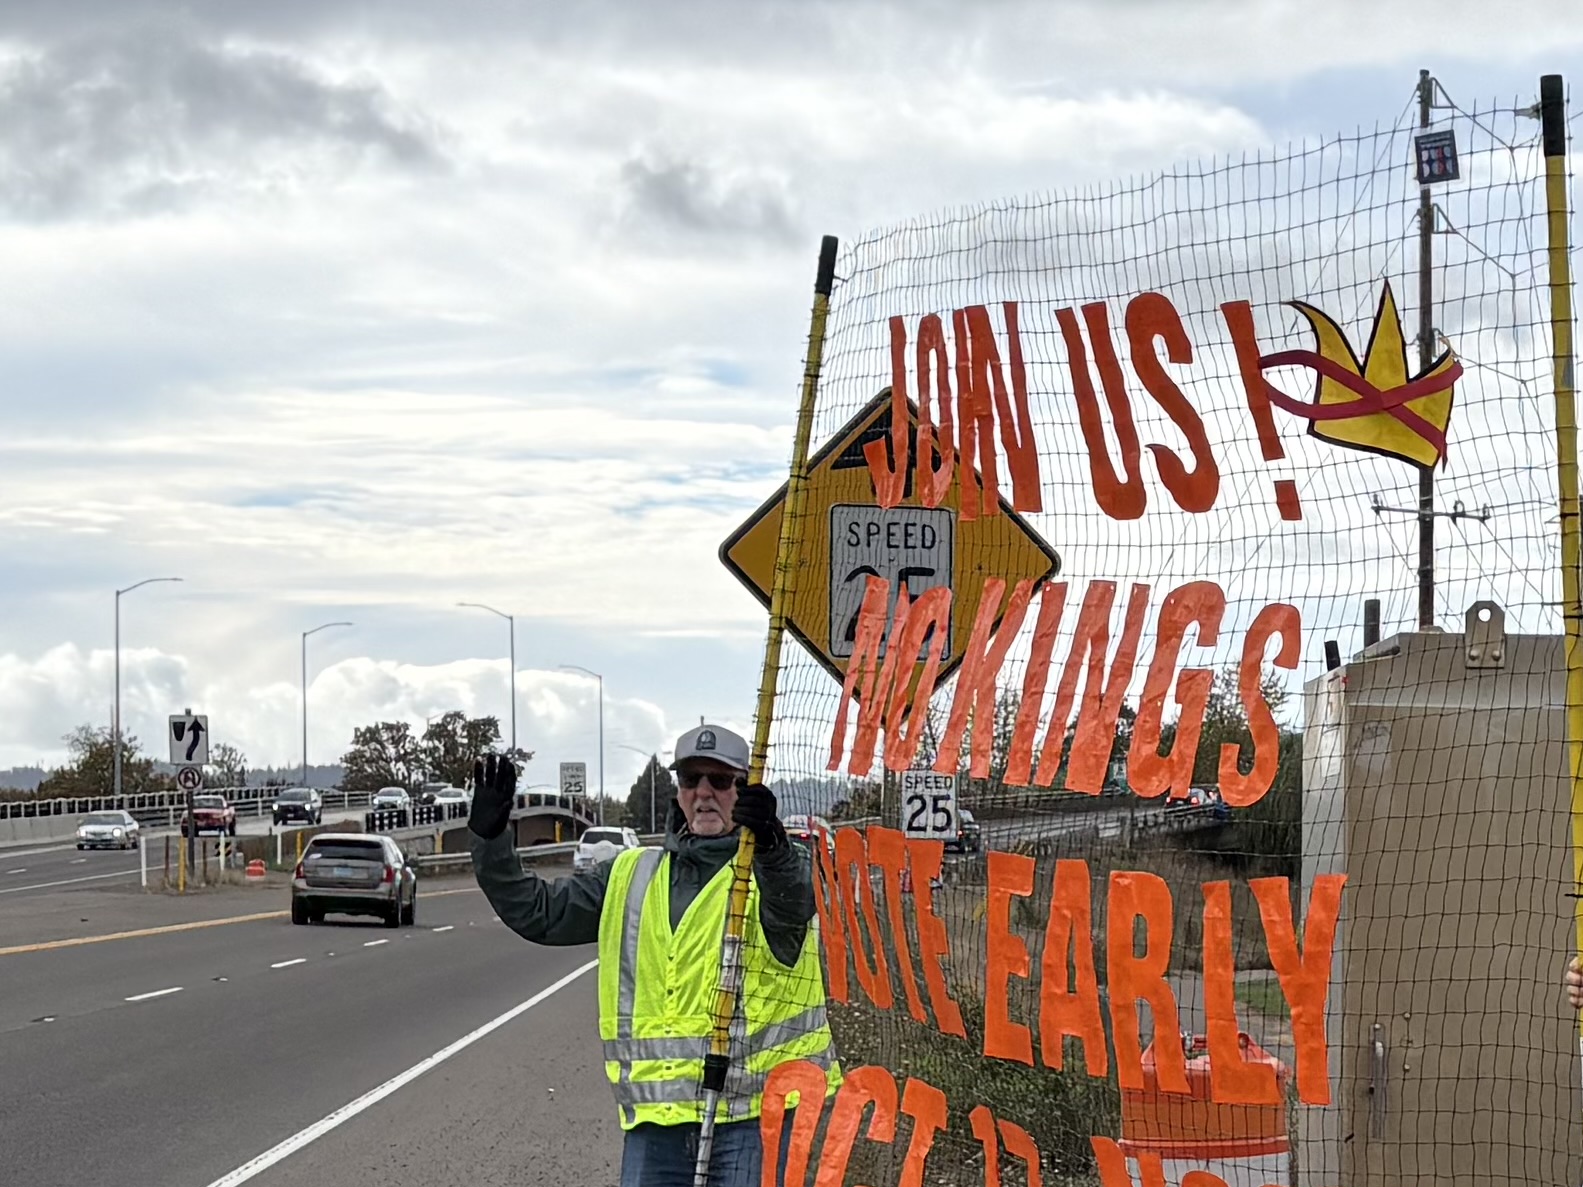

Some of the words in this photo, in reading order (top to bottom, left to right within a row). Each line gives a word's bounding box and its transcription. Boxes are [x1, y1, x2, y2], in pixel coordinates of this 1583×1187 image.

[863, 299, 1043, 521] JOIN
[847, 521, 937, 550] SPEED
[825, 575, 953, 777] NO
[932, 576, 1301, 808] KINGS
[563, 780, 583, 793] 25
[905, 775, 953, 790] SPEED
[906, 794, 953, 832] 25
[812, 825, 967, 1039] VOTE
[984, 850, 1348, 1105] EARLY
